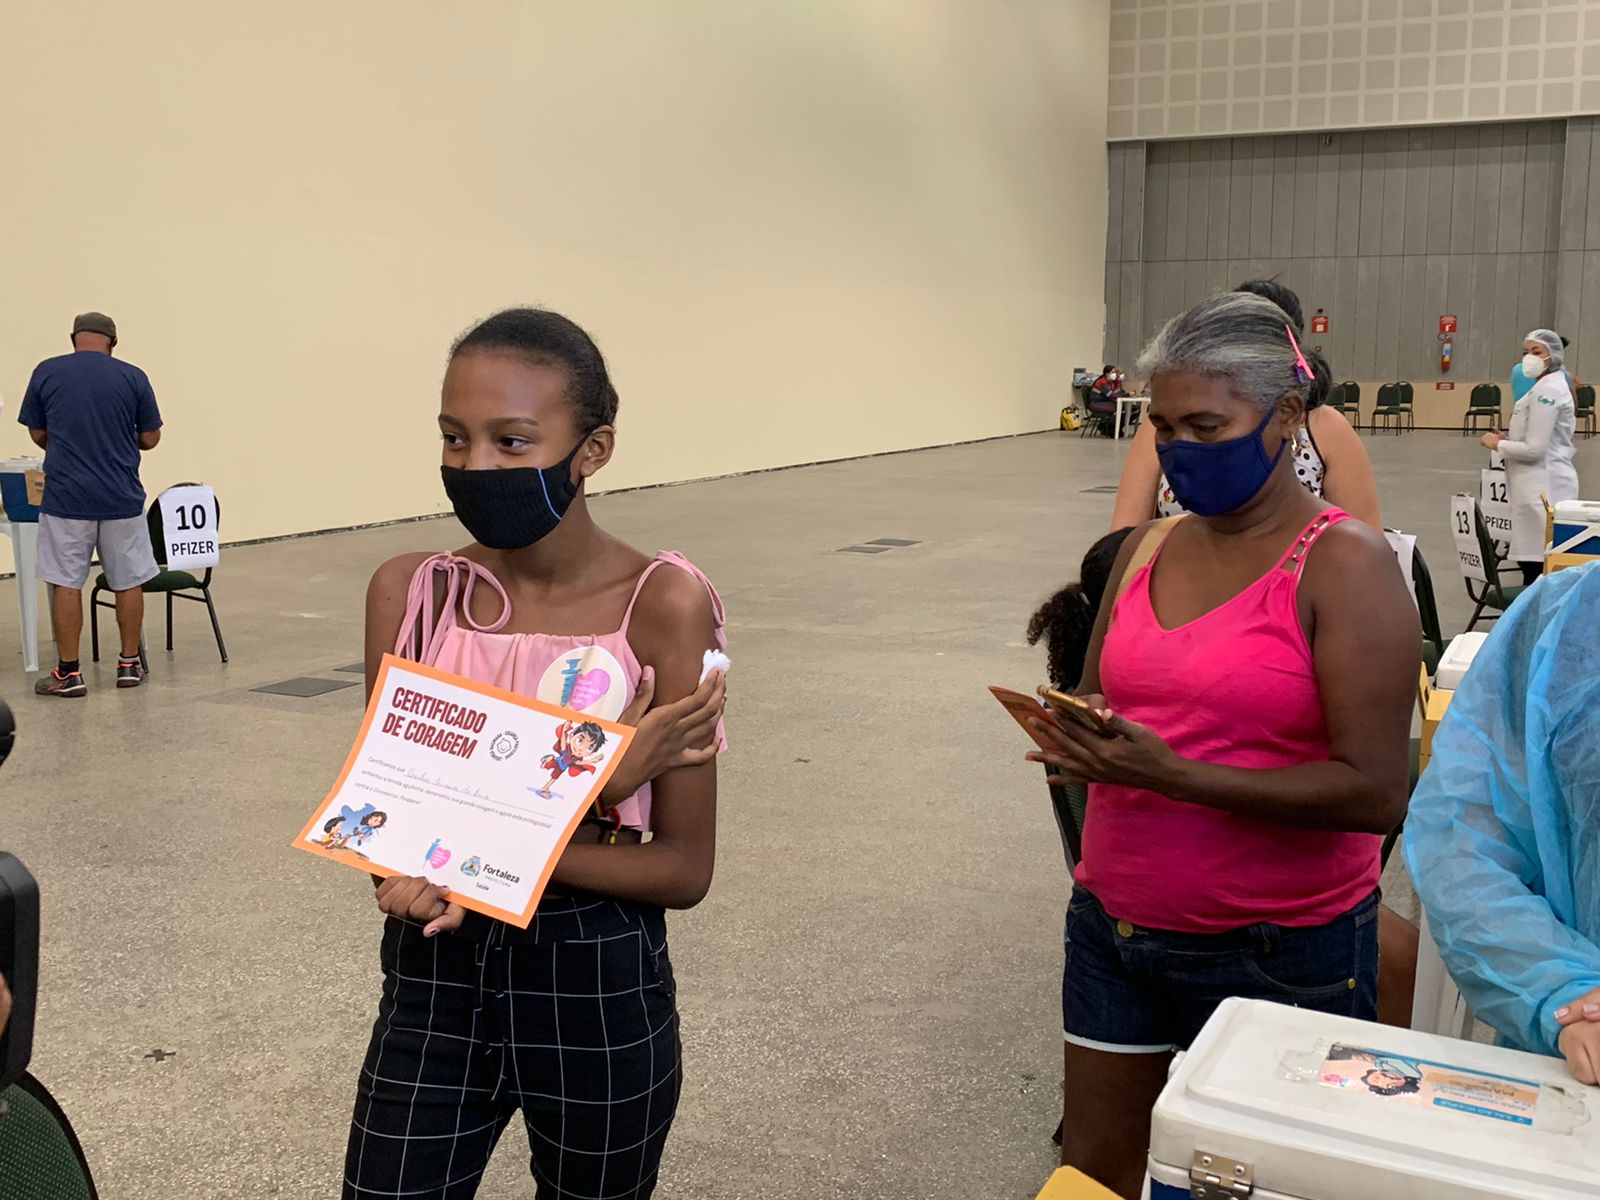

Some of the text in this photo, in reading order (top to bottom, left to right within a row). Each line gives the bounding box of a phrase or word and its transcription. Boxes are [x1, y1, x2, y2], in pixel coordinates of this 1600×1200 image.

[1489, 482, 1508, 503] 12
[175, 504, 206, 530] 10
[1456, 510, 1470, 534] 13
[171, 540, 215, 556] PFIZER
[1459, 551, 1482, 568] PFIZER
[392, 687, 487, 734] CERTIFICADO
[382, 712, 406, 737] DE
[403, 719, 478, 760] CORAGEM
[483, 864, 520, 884] Fortaleza
